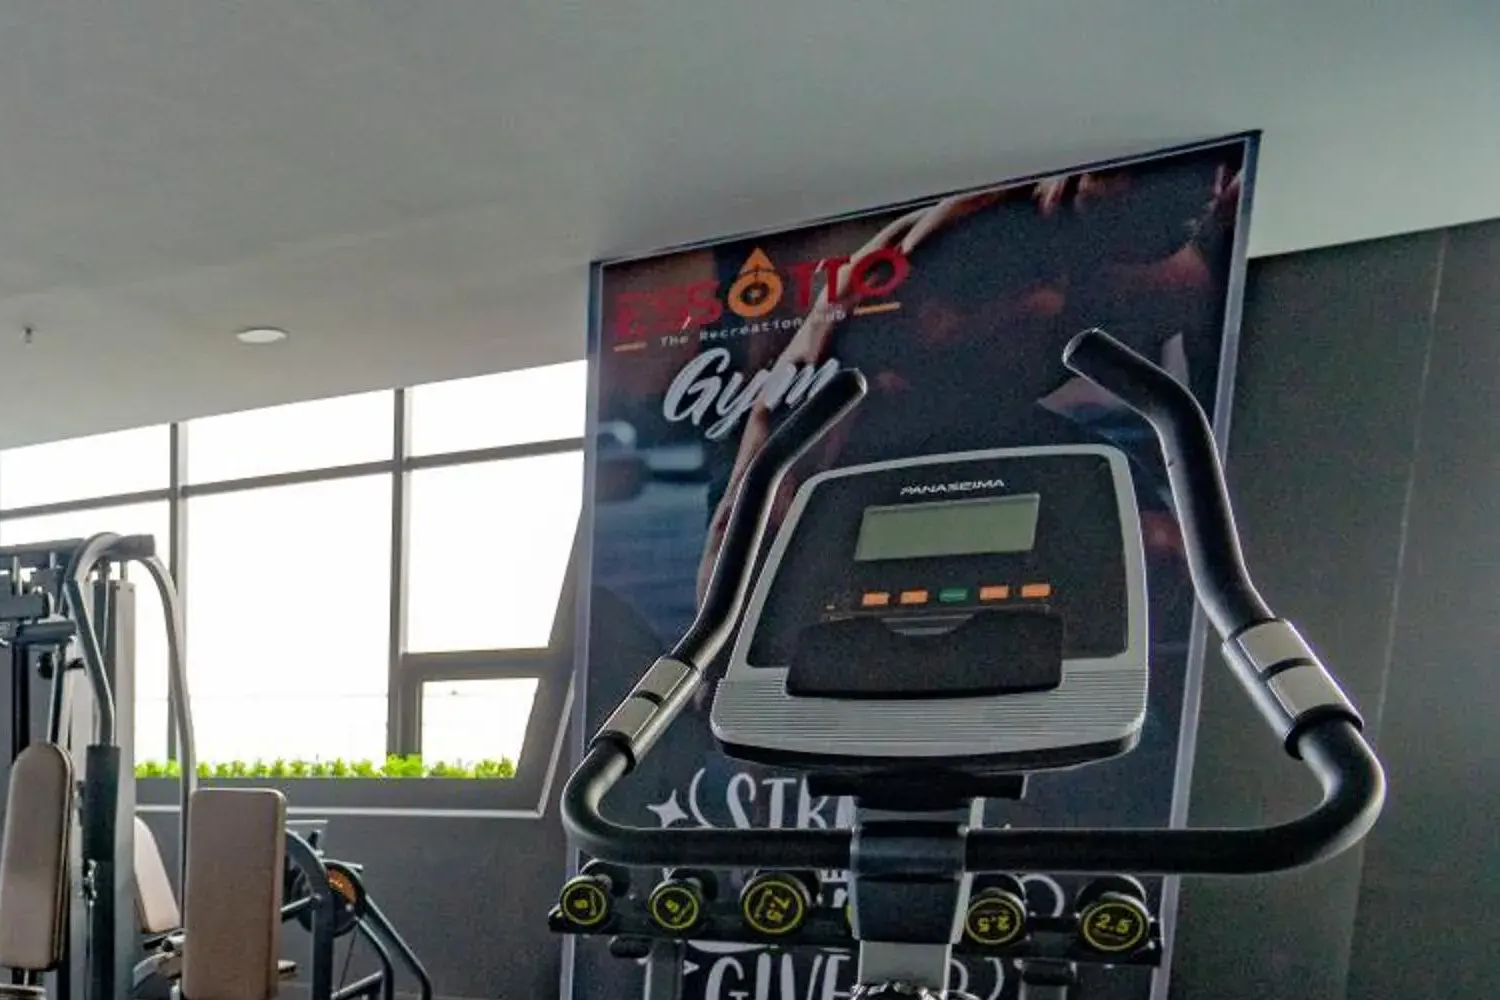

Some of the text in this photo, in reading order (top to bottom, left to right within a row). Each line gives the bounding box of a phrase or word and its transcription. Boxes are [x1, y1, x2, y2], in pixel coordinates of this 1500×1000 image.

[663, 348, 841, 440] Gym
[900, 478, 1004, 497] PANASEIMA
[1096, 912, 1133, 936] 2.5
